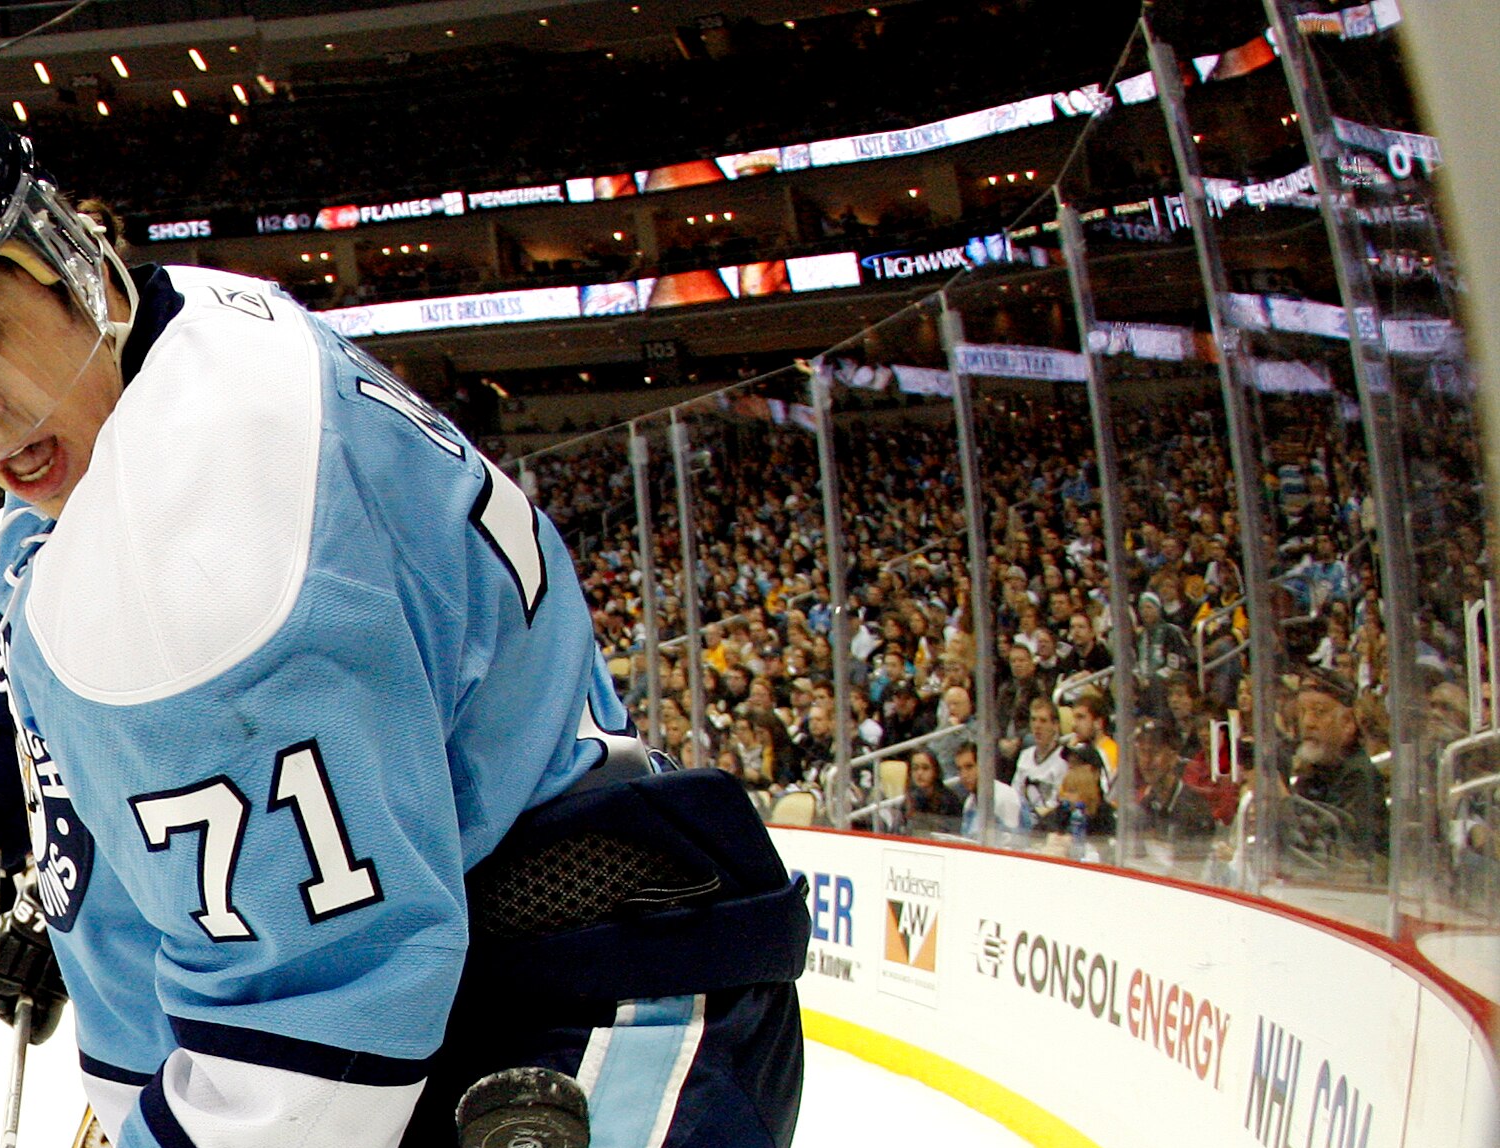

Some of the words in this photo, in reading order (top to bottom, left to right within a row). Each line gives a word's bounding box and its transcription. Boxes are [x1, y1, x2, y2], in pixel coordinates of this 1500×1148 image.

[361, 199, 433, 223] FLAMES
[148, 219, 212, 242] SHOTS
[127, 735, 385, 943] 71
[885, 866, 941, 900] Andersen
[1013, 930, 1122, 1027] CONSOL
[1127, 967, 1232, 1091] ENERGY
